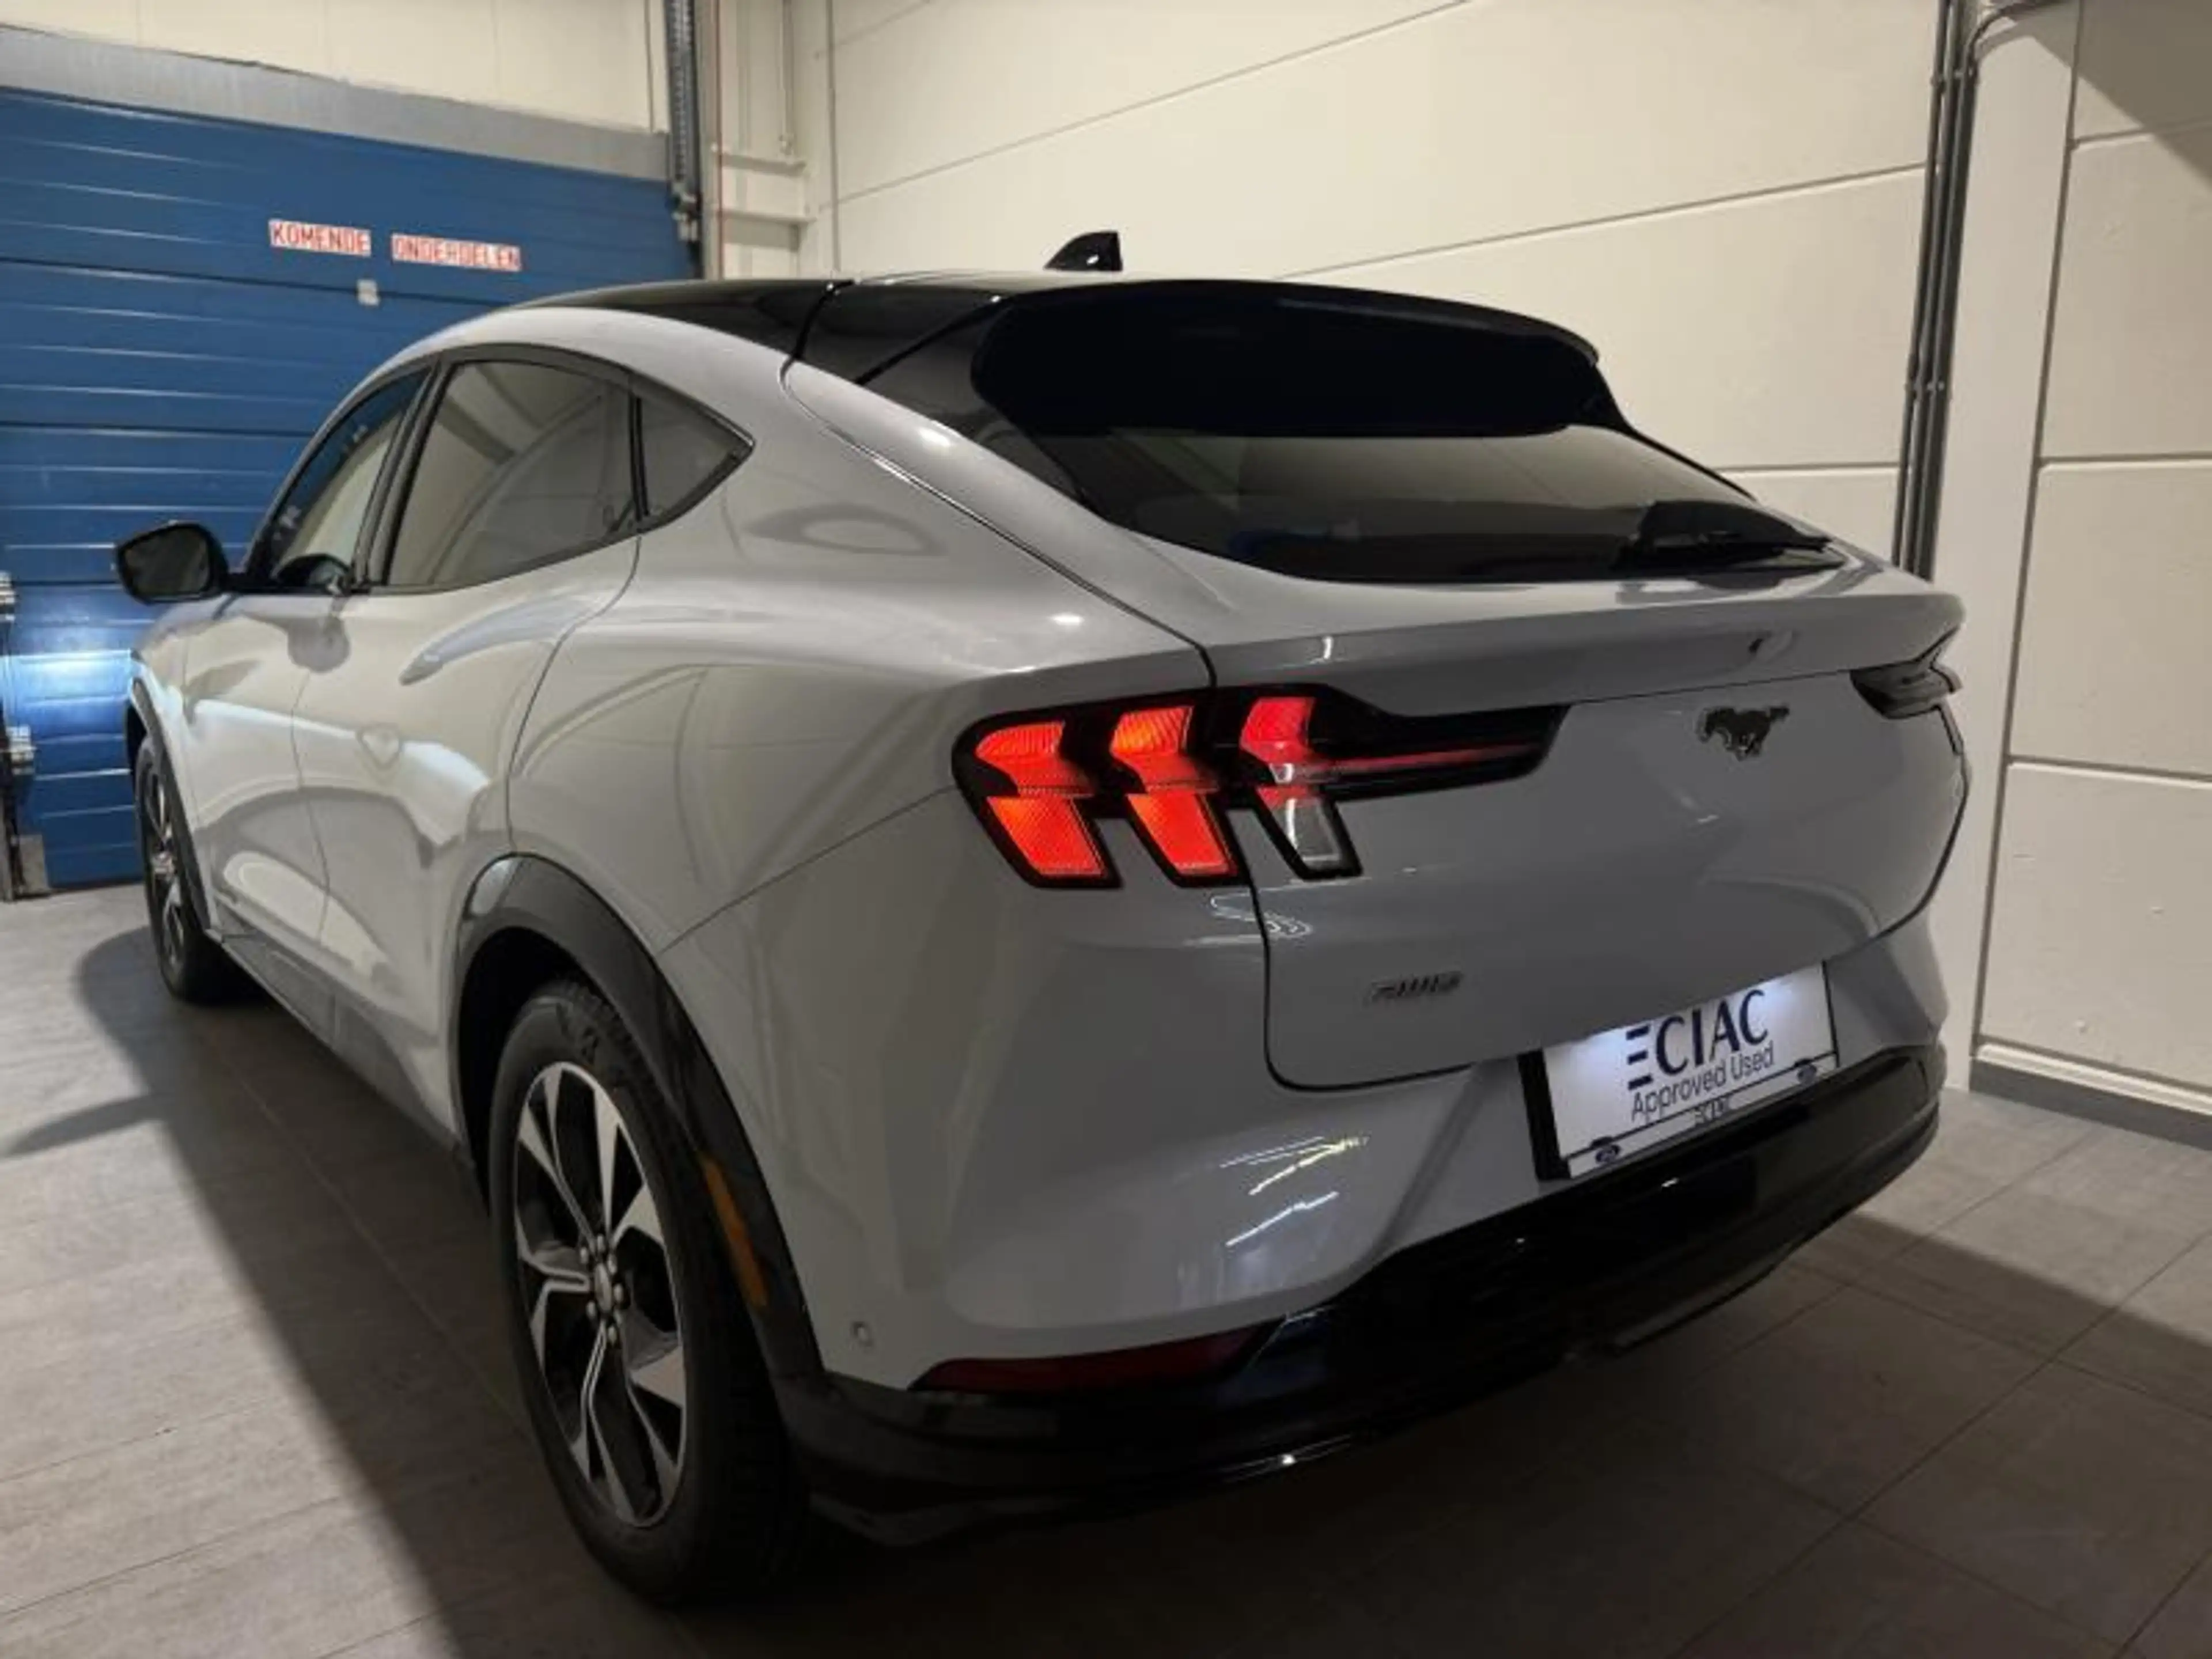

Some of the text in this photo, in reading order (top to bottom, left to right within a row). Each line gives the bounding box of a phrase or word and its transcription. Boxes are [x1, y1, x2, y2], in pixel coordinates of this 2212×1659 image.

[272, 221, 520, 269] KOMENDE ONDERDELEN
[1632, 1060, 1726, 1122] Approved
[1730, 1041, 1775, 1080] Used
